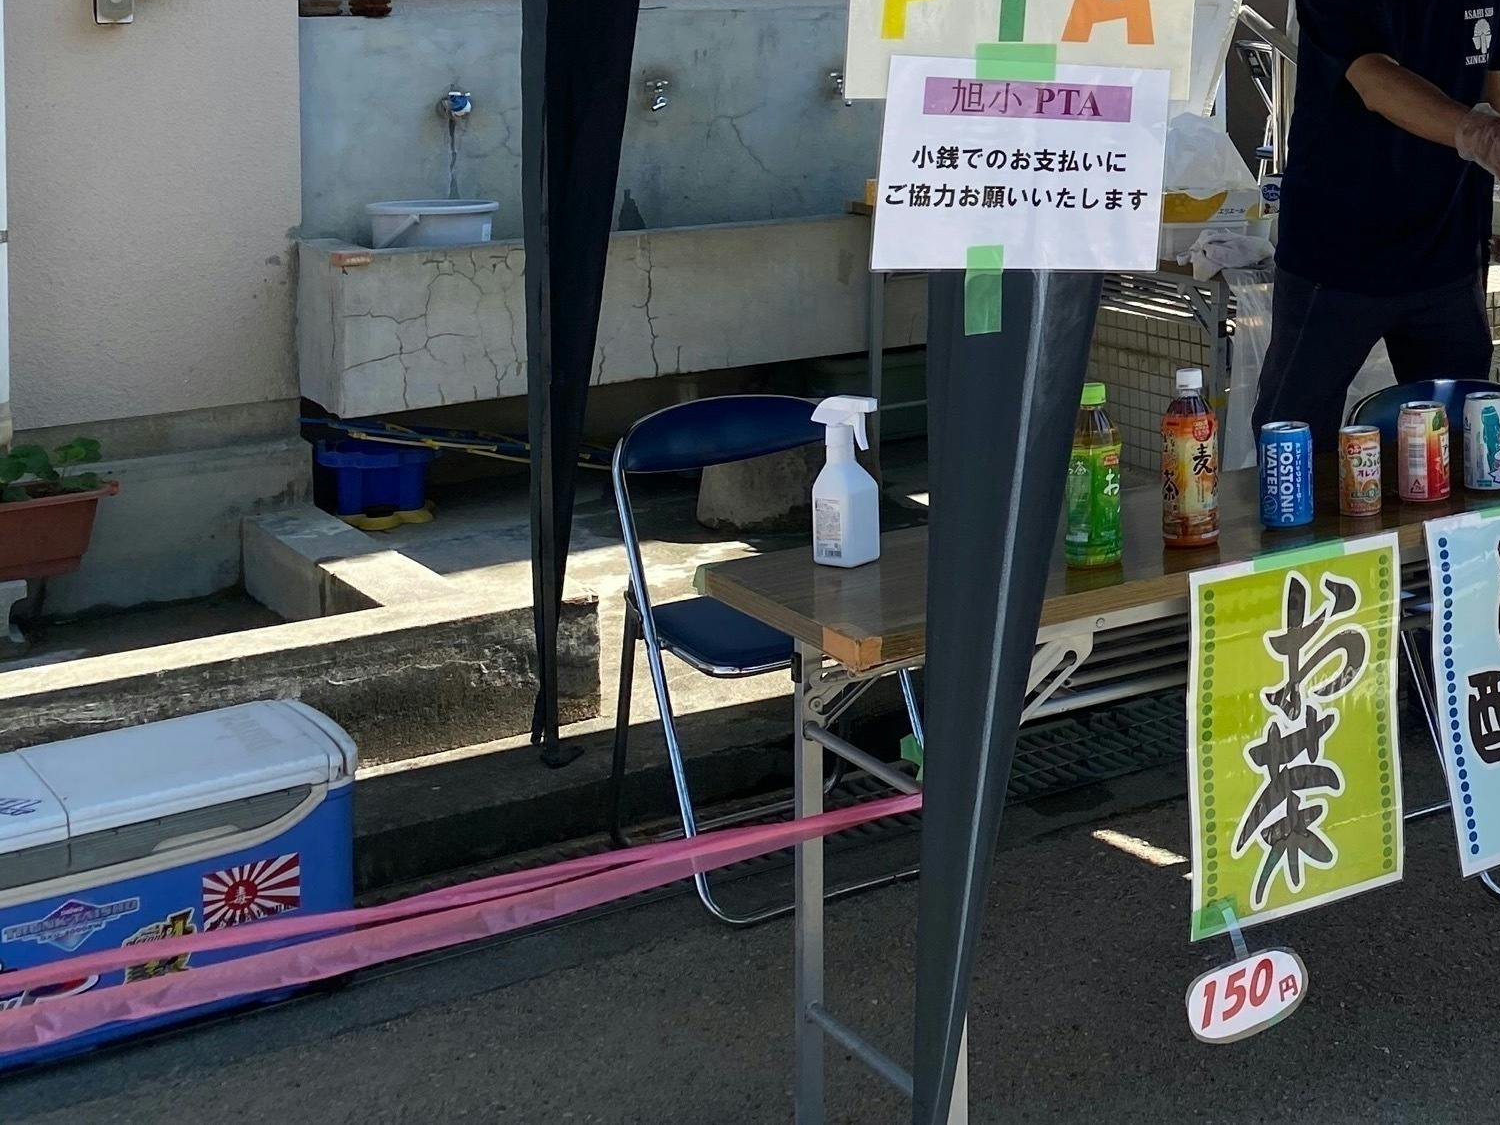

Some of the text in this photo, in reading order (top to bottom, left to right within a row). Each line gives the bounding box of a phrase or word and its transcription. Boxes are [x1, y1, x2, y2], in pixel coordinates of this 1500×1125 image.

[950, 79, 1102, 117] 旭小 PTA
[911, 146, 1127, 173] 小銭でのお支払いに
[884, 183, 1148, 211] ご協力お願いいたします
[1218, 207, 1246, 215] エリエール
[1266, 443, 1278, 495] WATER
[1280, 442, 1294, 523] POSTONIC
[1236, 575, 1368, 905] お茶
[1200, 958, 1301, 1030] 150円
